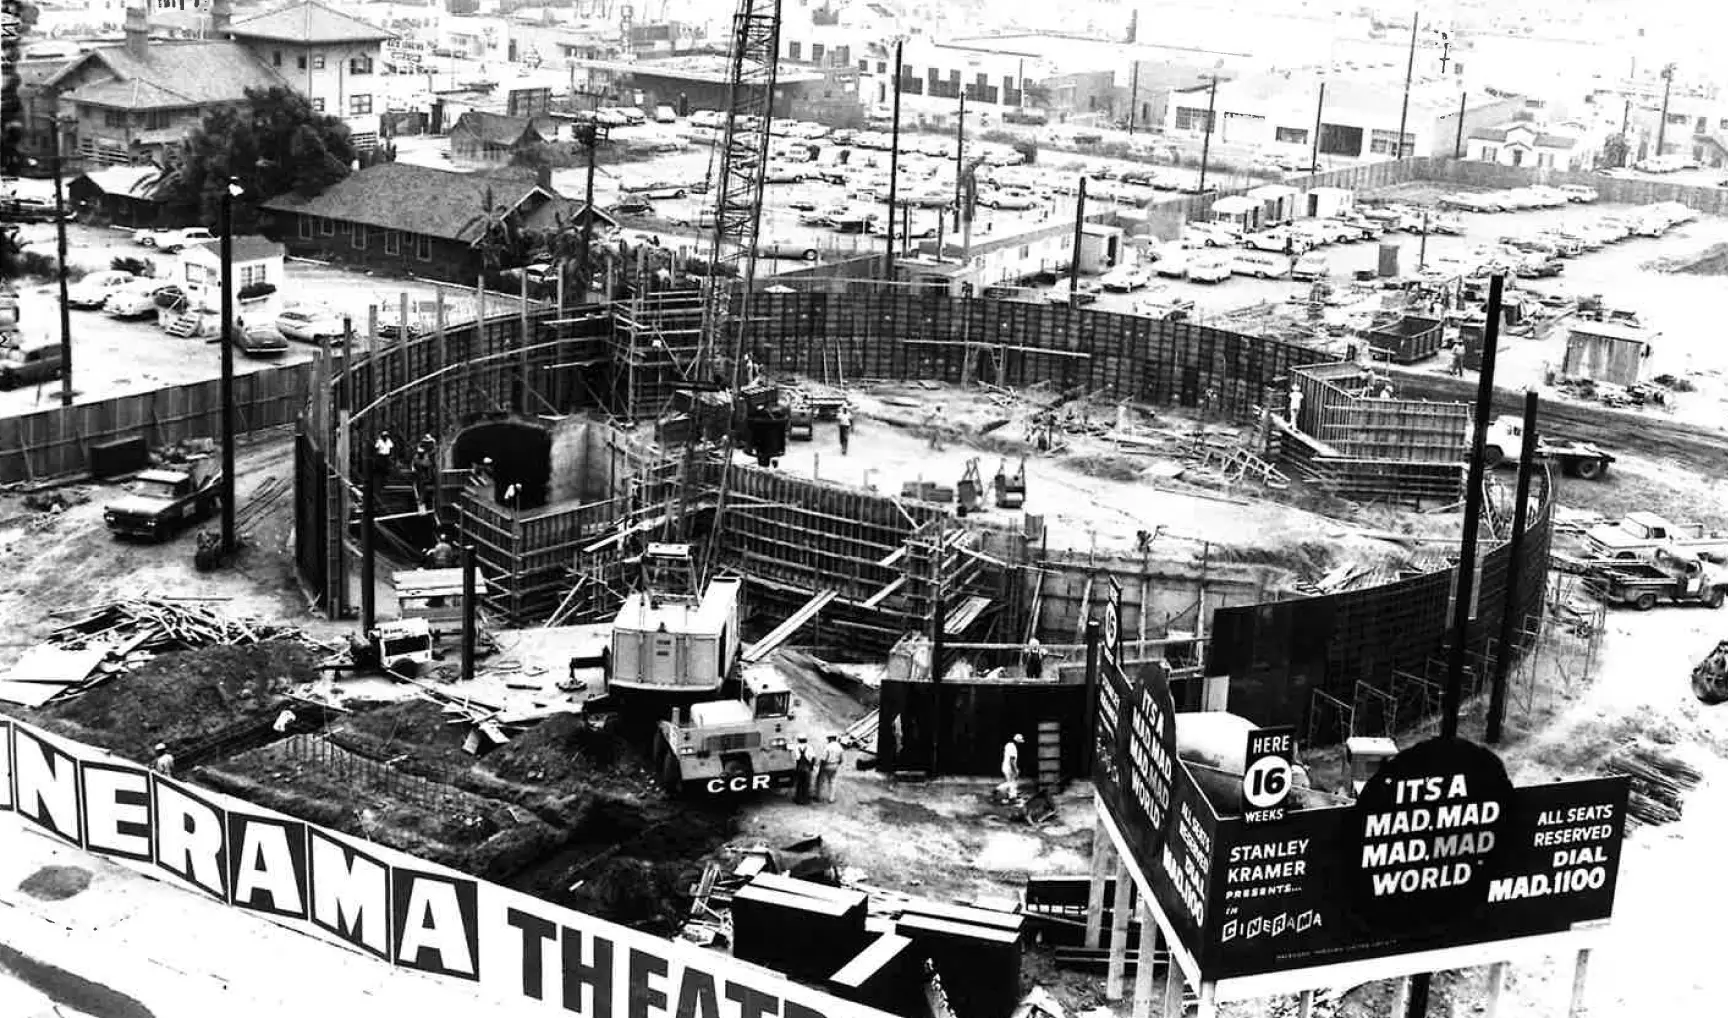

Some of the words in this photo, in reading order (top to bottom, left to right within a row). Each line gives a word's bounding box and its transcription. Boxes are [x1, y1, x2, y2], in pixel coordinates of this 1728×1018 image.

[1253, 734, 1290, 754] HERE
[706, 774, 771, 794] CCR
[1252, 767, 1286, 796] 16
[1447, 773, 1467, 798] A
[1244, 807, 1284, 823] WEEKS
[1537, 809, 1564, 826] ALL
[1567, 803, 1613, 823] SEATS
[1534, 824, 1612, 847] RESERVED
[1229, 838, 1309, 862] STANLEY
[1552, 846, 1608, 868] DIAL
[1227, 860, 1306, 883] KRAMER
[1221, 908, 1322, 942] CINERAMA
